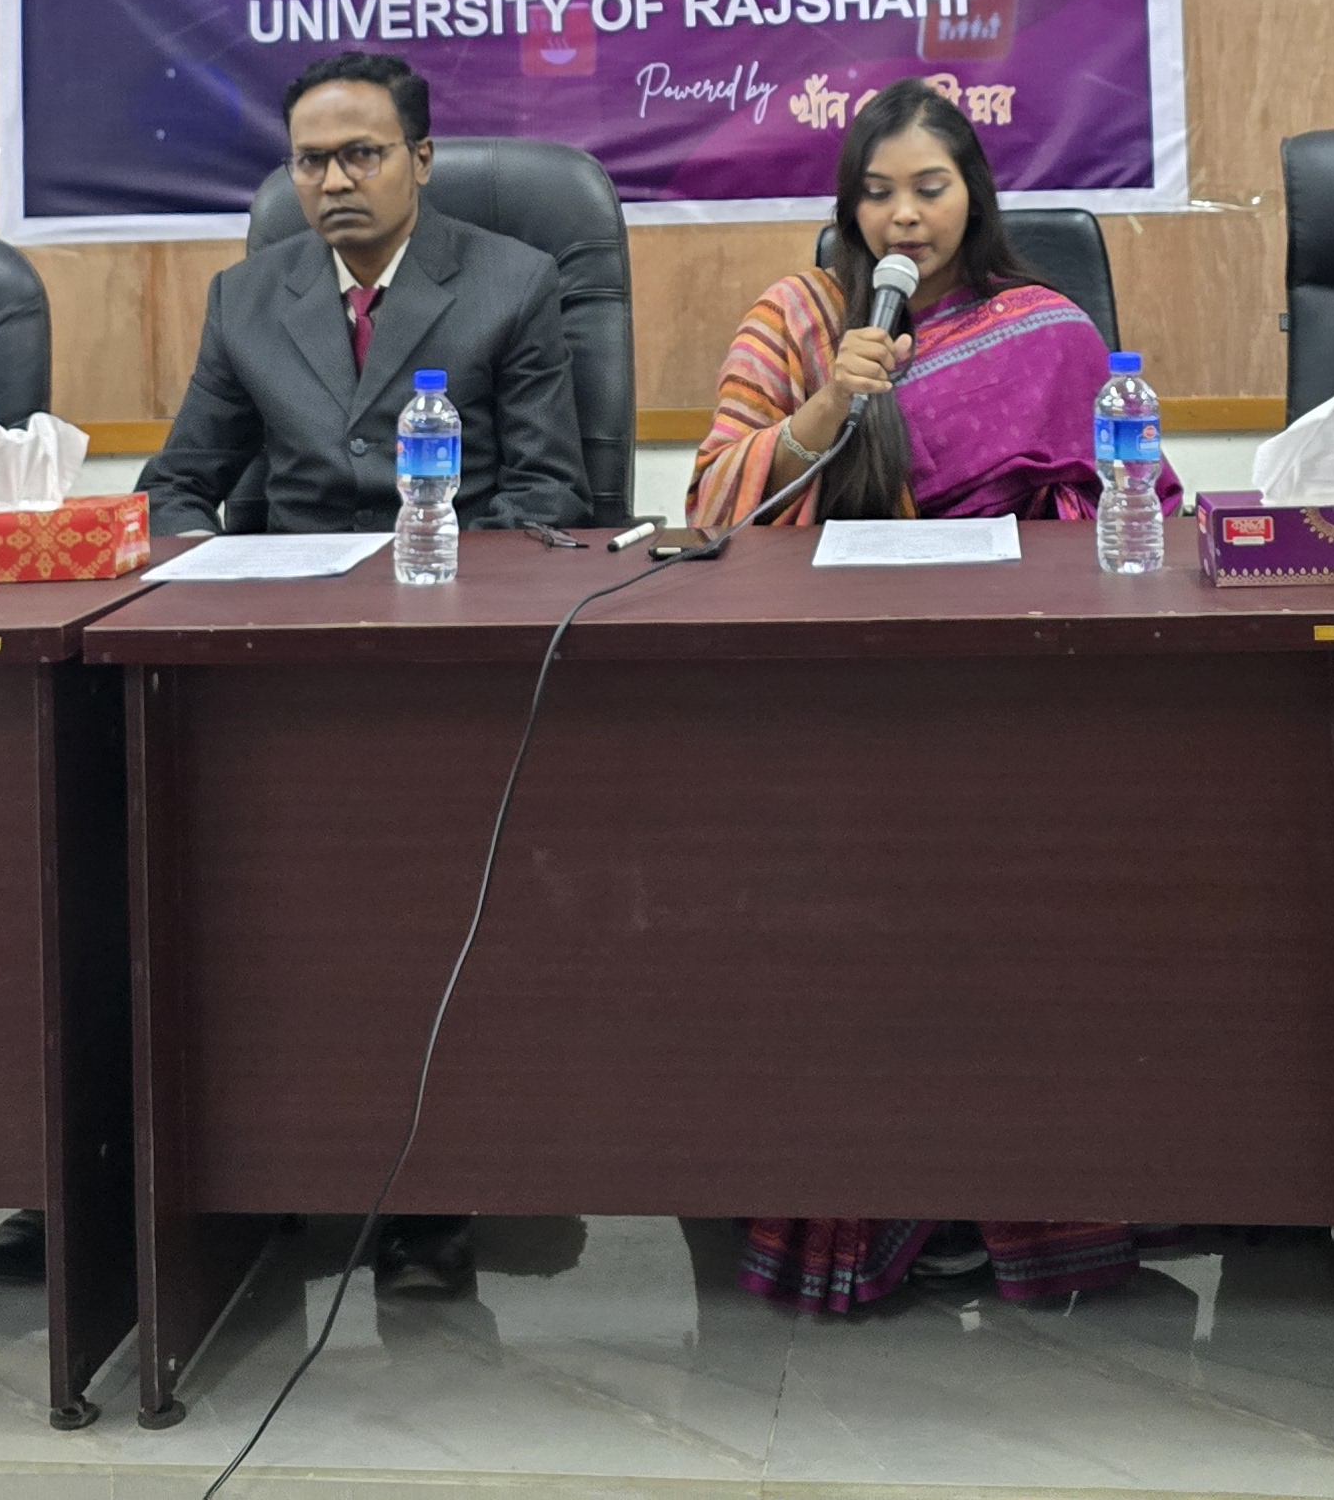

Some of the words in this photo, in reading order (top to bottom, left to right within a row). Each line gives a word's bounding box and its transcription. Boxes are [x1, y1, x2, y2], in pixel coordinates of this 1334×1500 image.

[636, 62, 742, 118] Powered
[745, 61, 779, 125] by
[965, 84, 1016, 125] ঘর
